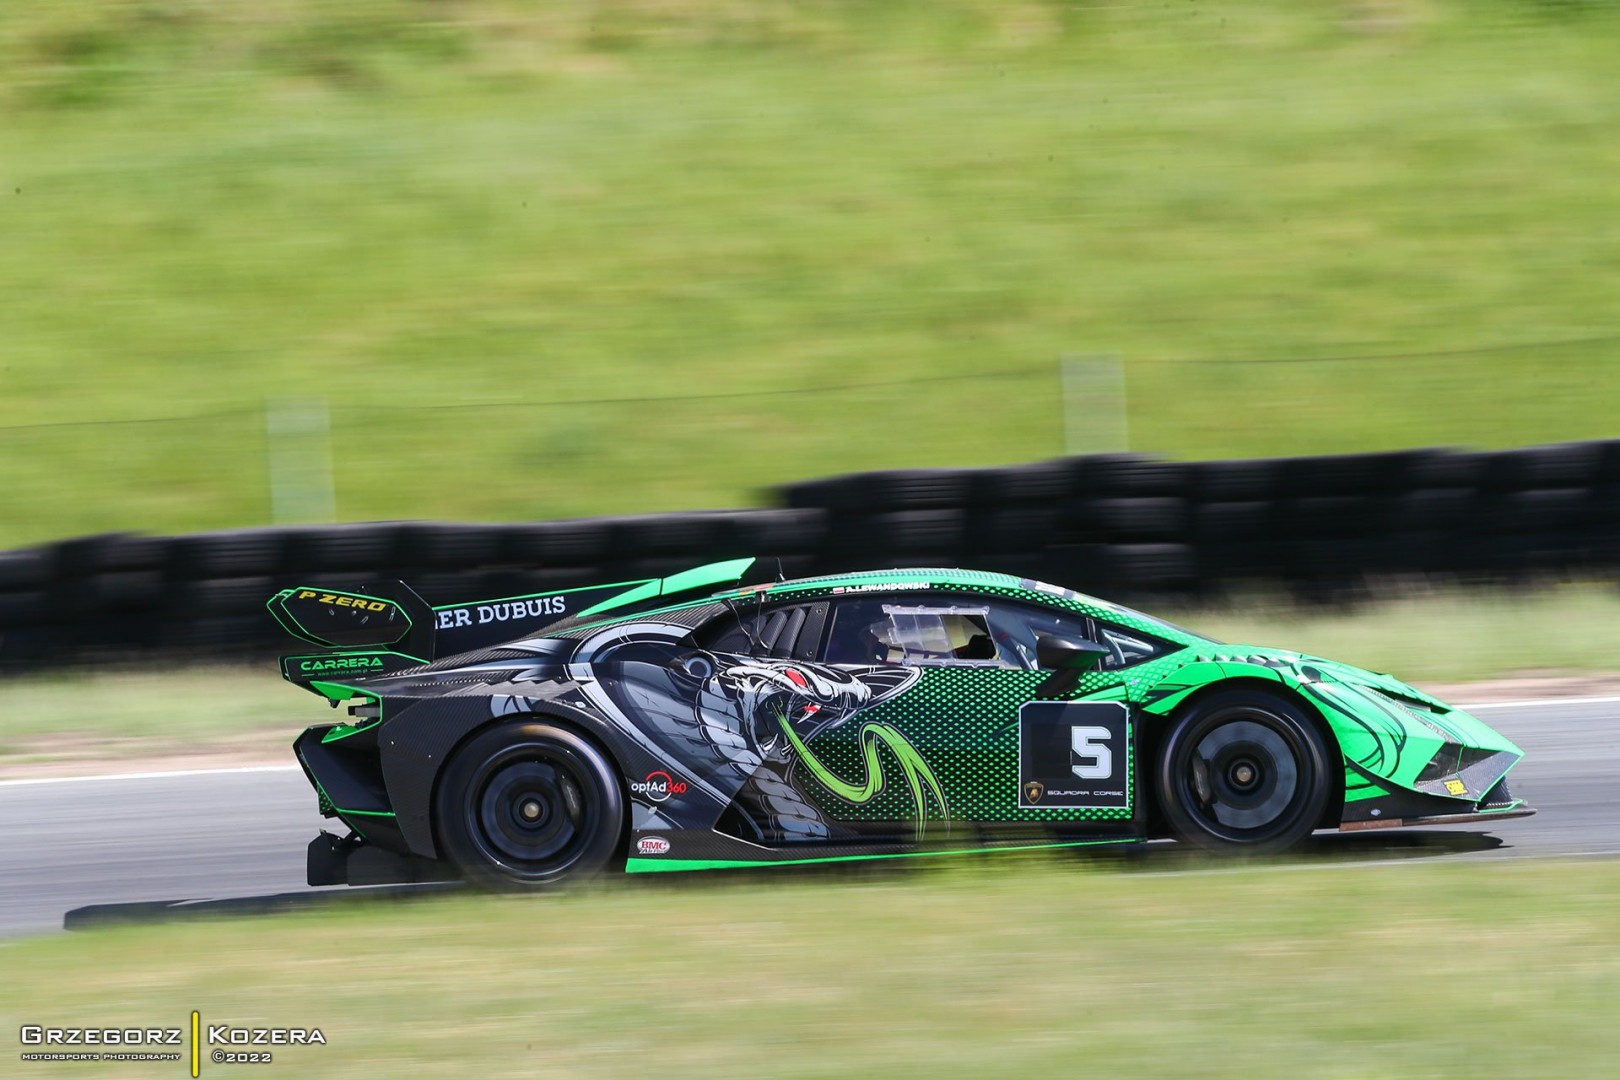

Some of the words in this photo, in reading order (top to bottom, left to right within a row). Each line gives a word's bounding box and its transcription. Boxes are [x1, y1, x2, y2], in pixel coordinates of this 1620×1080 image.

[299, 591, 316, 599] P
[319, 594, 386, 611] ZERO
[435, 608, 472, 630] ER
[477, 596, 566, 624] DUBUIS
[300, 657, 384, 671] CARRERA
[1071, 726, 1112, 779] 5
[631, 781, 687, 794] optAd360
[641, 841, 667, 850] BMC
